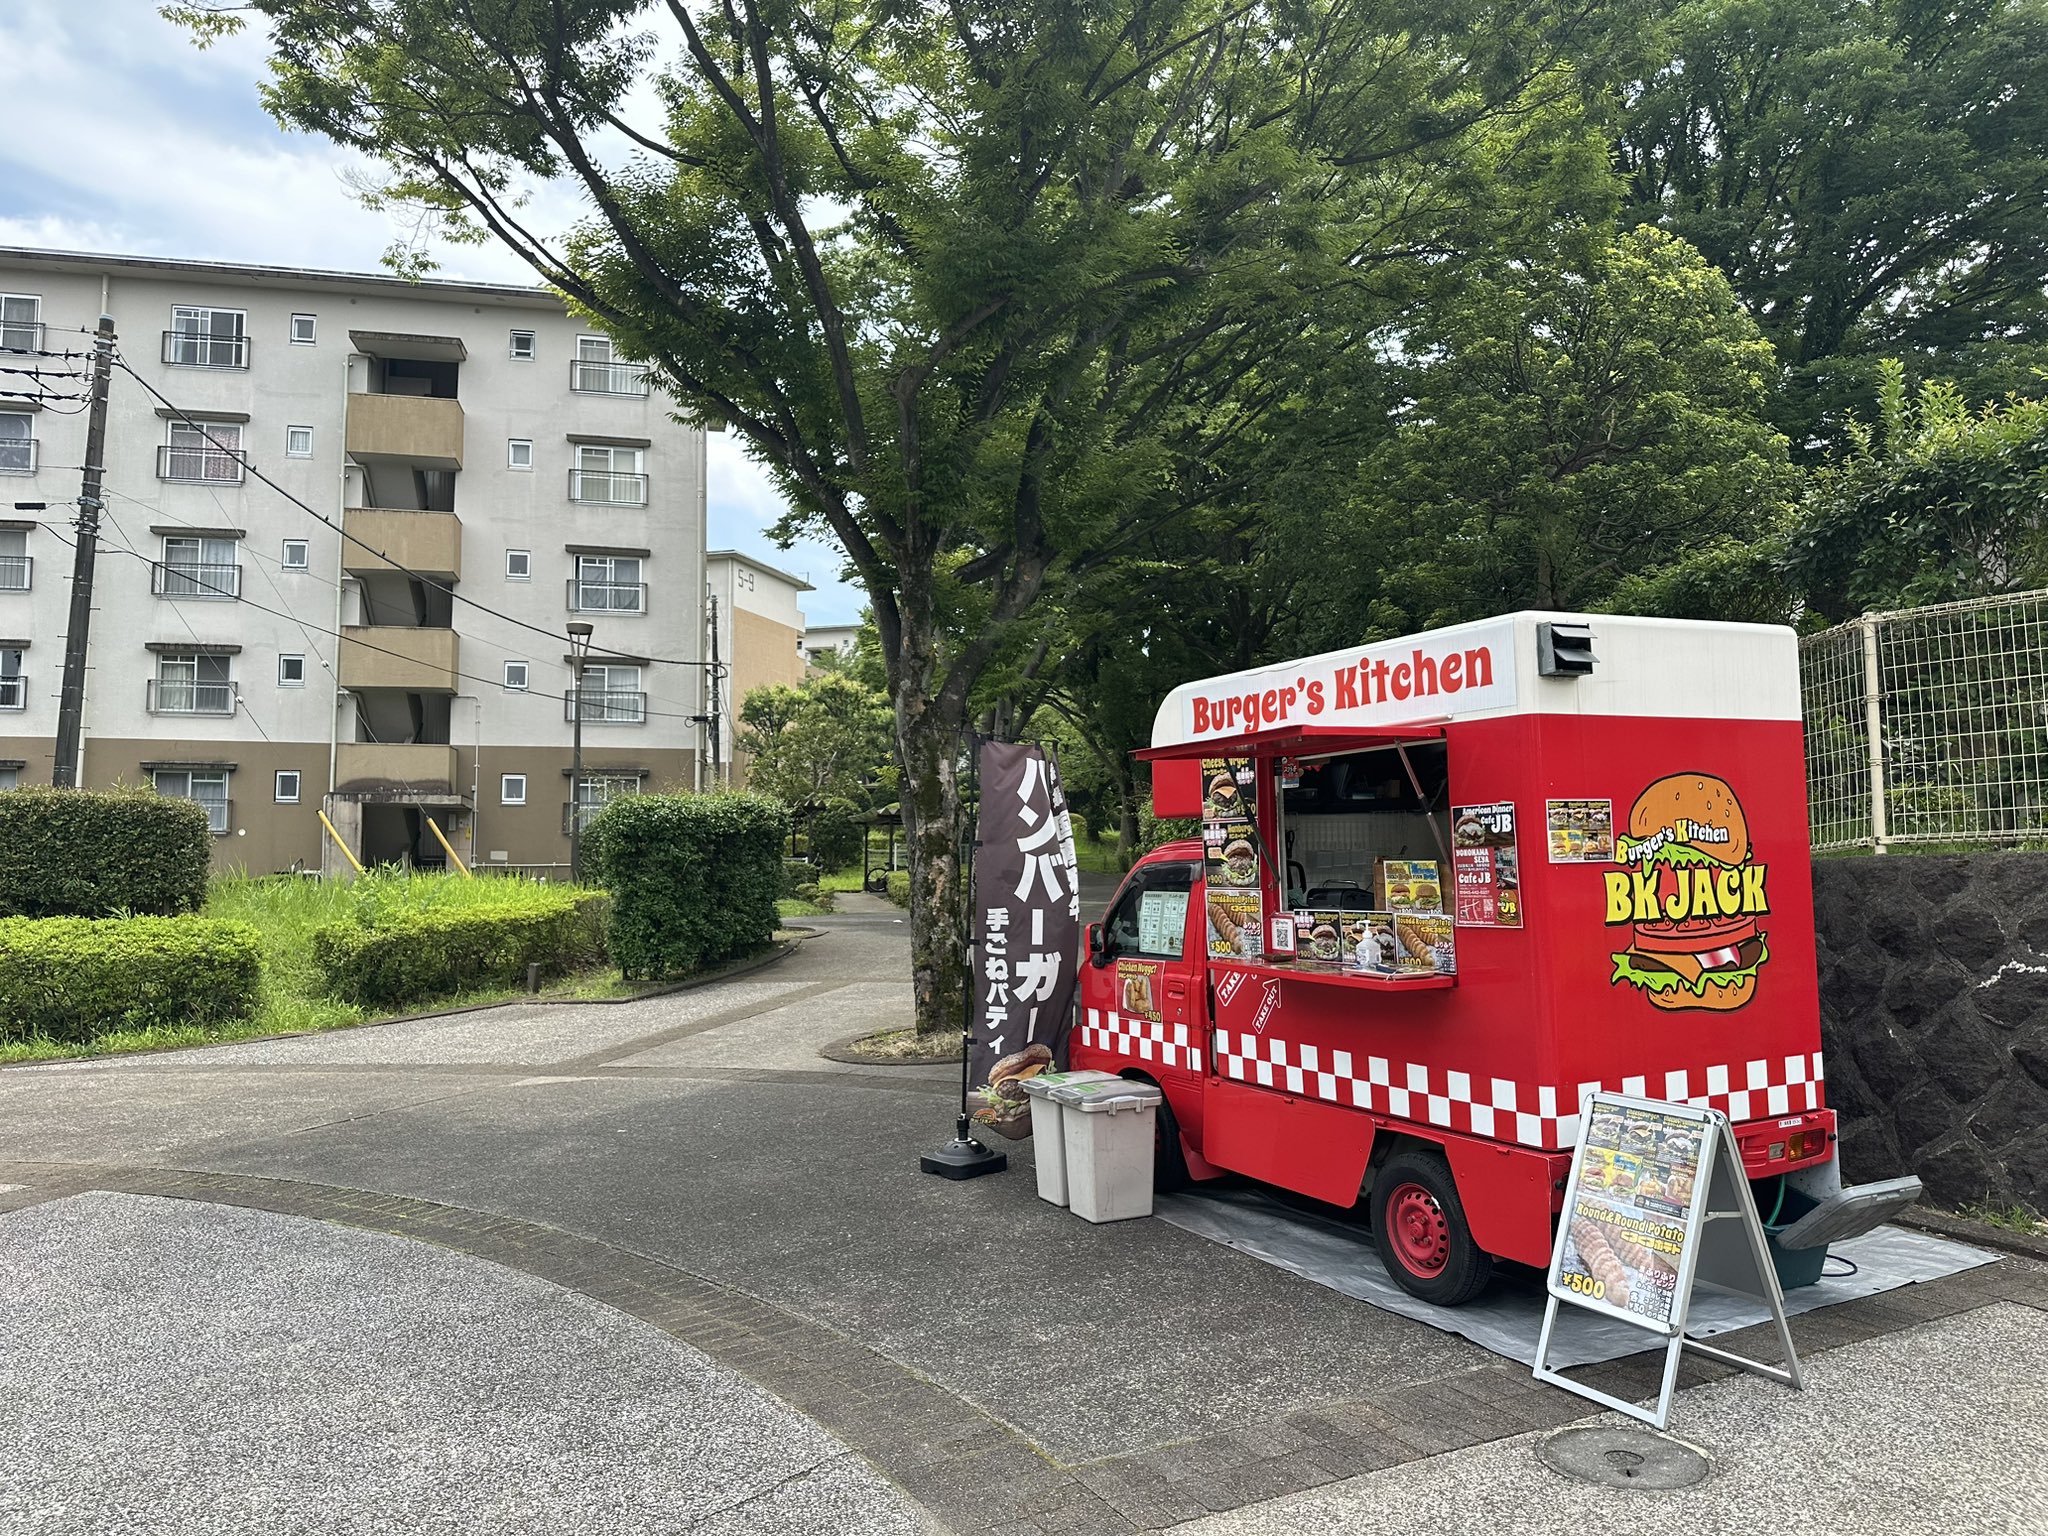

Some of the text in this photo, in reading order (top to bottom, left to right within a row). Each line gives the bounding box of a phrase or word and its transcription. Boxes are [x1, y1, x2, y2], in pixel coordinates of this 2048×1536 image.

[1192, 647, 1493, 734] Burger's Kitchen
[1462, 803, 1513, 816] American Dinner
[1480, 813, 1513, 834] Cafe JB
[1614, 818, 1730, 865] Burger's Kitchen
[1458, 872, 1492, 884] Cafe JB
[1013, 757, 1064, 1043] ハンバーガー
[1603, 863, 1770, 926] BK JACK
[1500, 902, 1517, 914] JB
[1210, 941, 1232, 954] ¥500
[1117, 961, 1158, 976] Chicken Nugget
[984, 907, 1010, 1056] 手ごねパティ
[1255, 985, 1278, 1029] TAKE OUT
[1575, 1203, 1648, 1233] Round&Round
[1647, 1223, 1684, 1242] Potato
[1562, 1272, 1606, 1300] ¥500
[1645, 1267, 1676, 1283] ふりふり
[1629, 1301, 1645, 1315] ¥50
